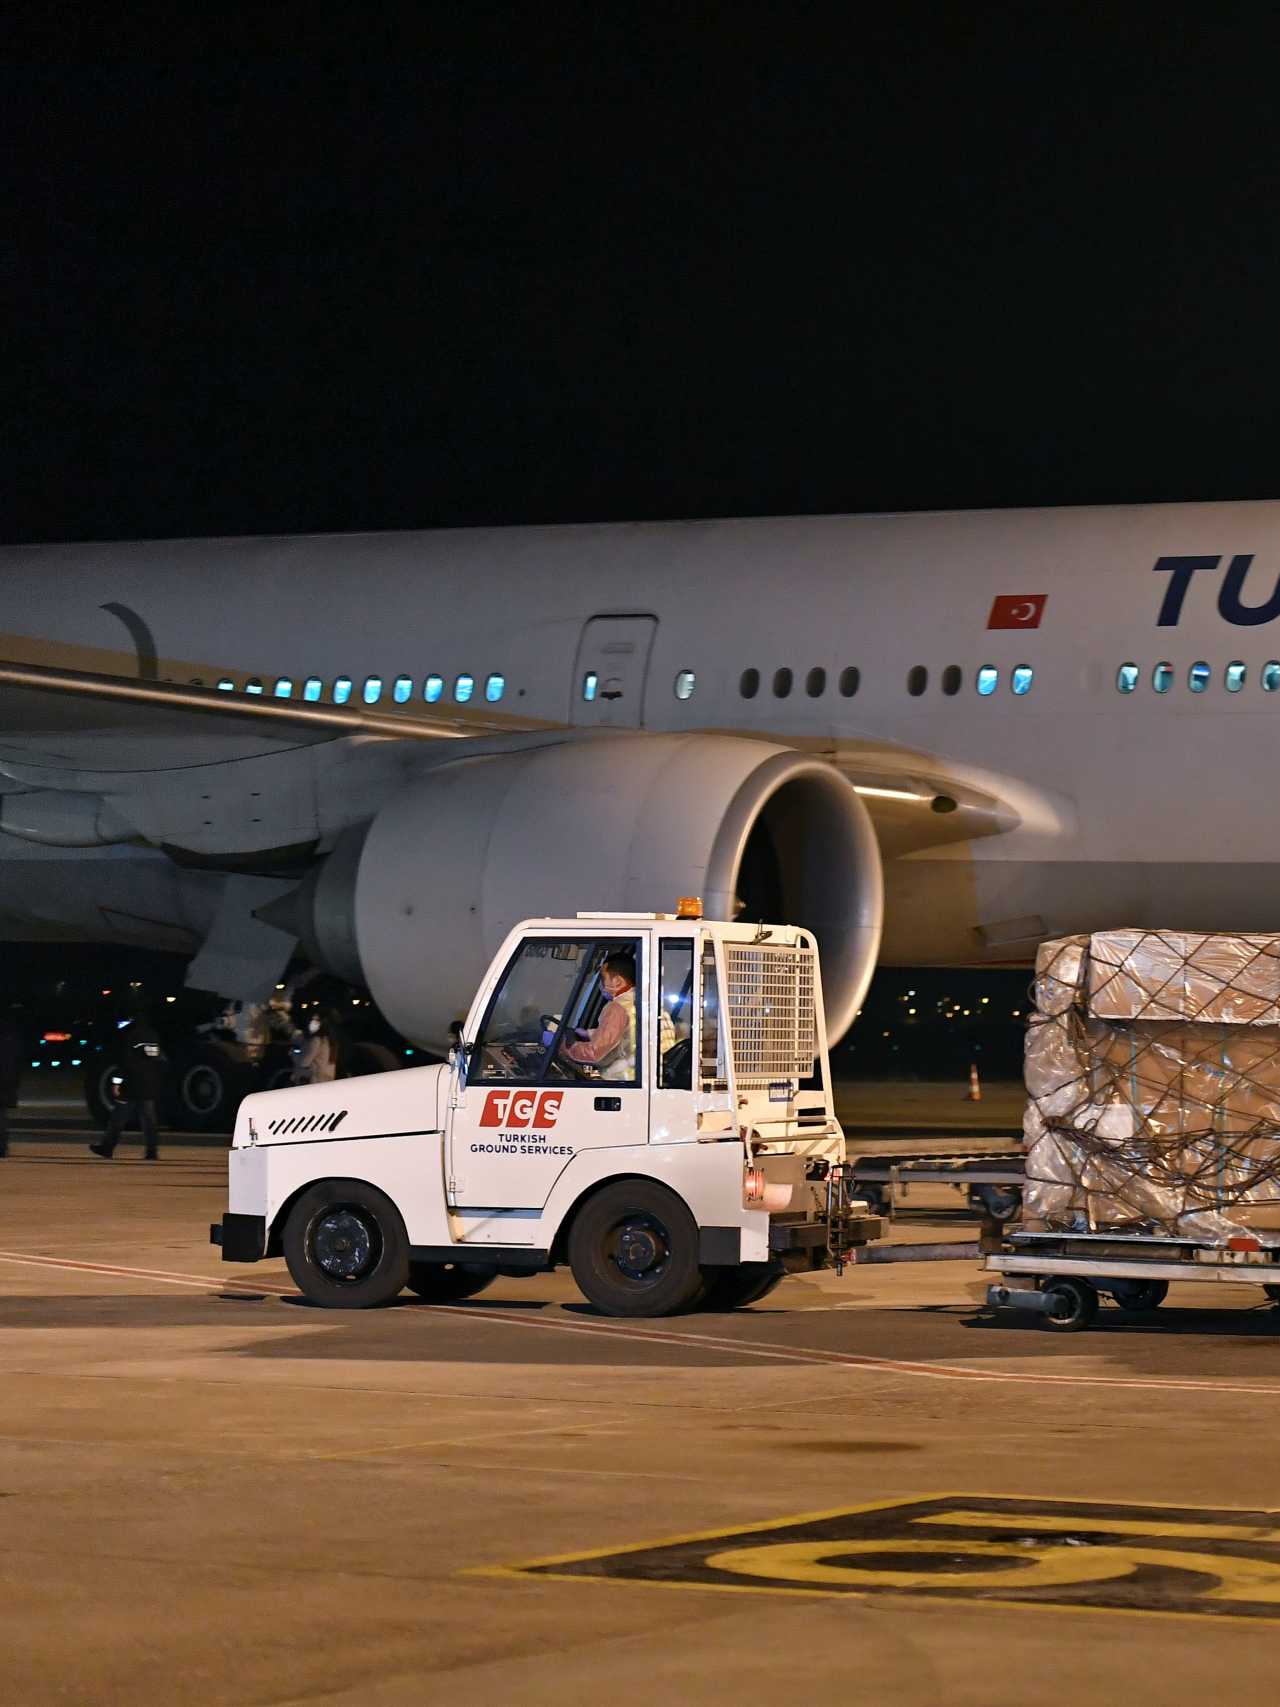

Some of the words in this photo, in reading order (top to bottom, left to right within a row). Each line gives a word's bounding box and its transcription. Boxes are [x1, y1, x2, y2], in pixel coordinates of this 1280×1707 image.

[489, 1096, 562, 1122] TGS
[499, 1134, 546, 1143] TURKISH
[470, 1144, 517, 1154] GROUND
[520, 1145, 574, 1155] SERVICES
